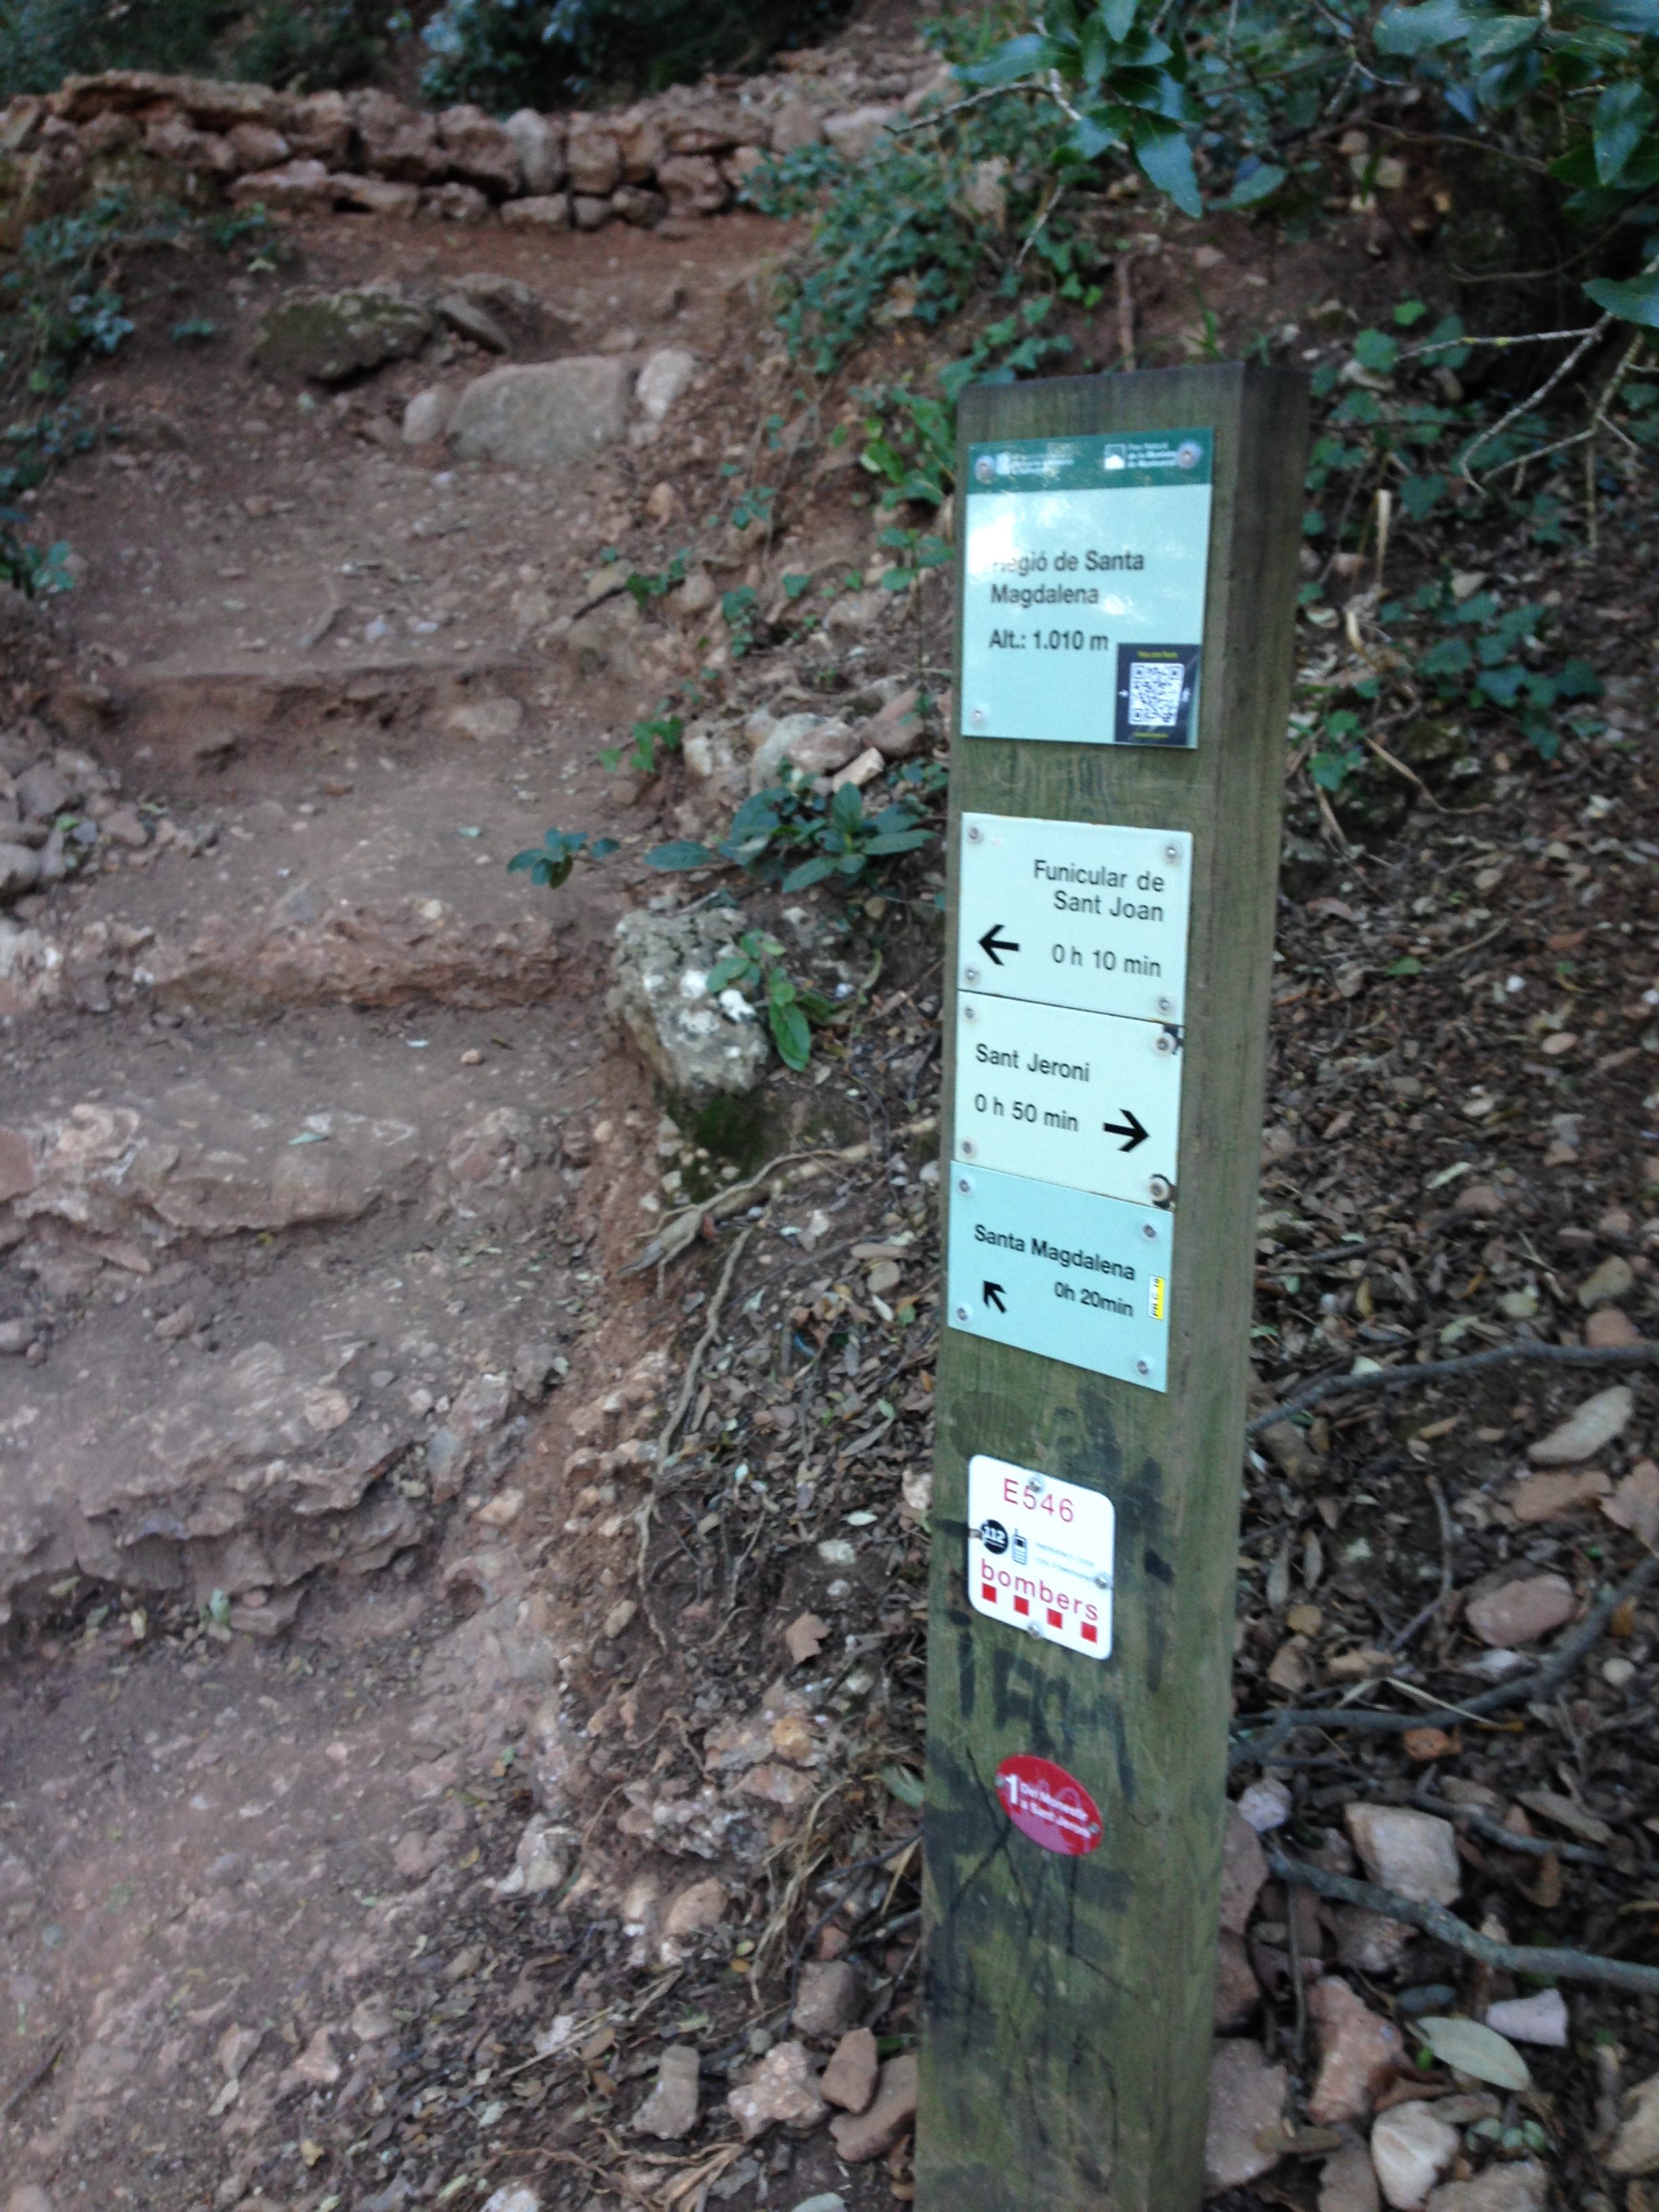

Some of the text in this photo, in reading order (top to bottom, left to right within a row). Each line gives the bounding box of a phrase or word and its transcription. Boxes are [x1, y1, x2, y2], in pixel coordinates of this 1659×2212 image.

[1054, 551, 1079, 571] de
[1085, 550, 1145, 571] Santa
[991, 583, 1099, 609] Magdalena
[989, 628, 1109, 651] Alt.: 1.010 m
[1033, 859, 1164, 892] Funicular de
[1054, 890, 1163, 921] Sant Joan
[1092, 949, 1116, 970] 10
[1124, 956, 1162, 977] min
[976, 1043, 1090, 1082] Sant Jeroni
[1012, 1101, 1037, 1122] 50
[1044, 1110, 1079, 1132] min
[975, 1224, 1135, 1281] Santa Magdalena
[1054, 1282, 1134, 1317] 0h 20min
[1004, 1477, 1073, 1522] E546
[981, 1559, 1099, 1621] bombers
[1005, 1773, 1019, 1805] 1
